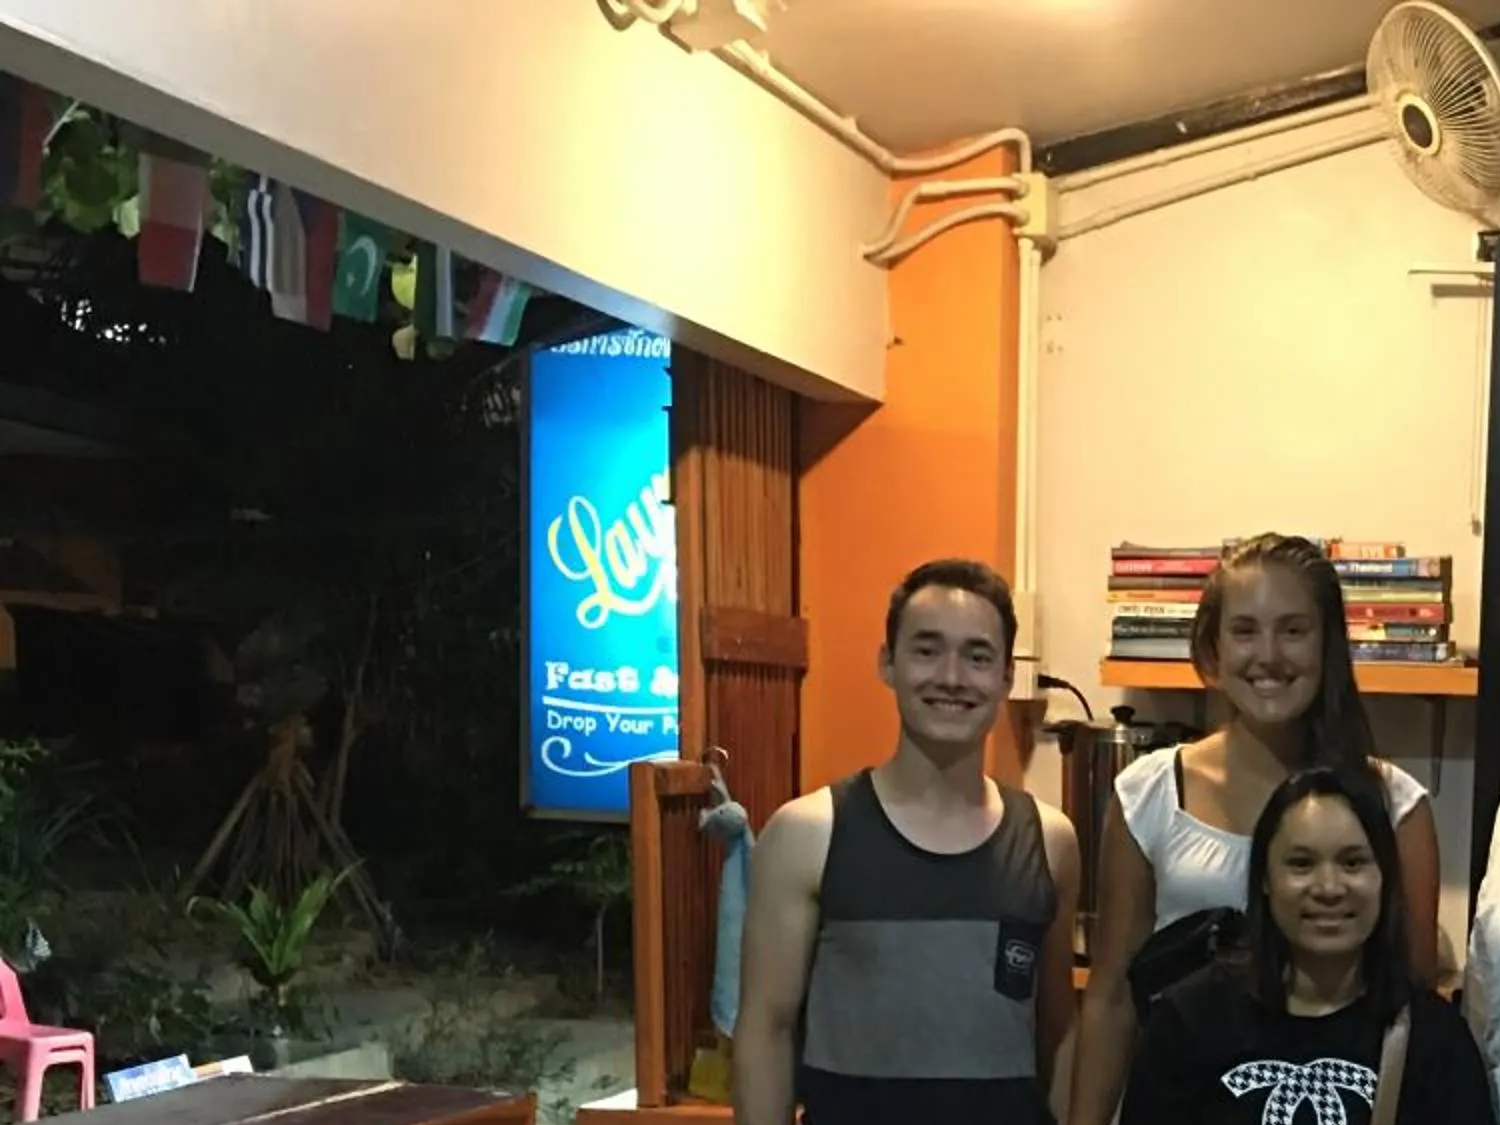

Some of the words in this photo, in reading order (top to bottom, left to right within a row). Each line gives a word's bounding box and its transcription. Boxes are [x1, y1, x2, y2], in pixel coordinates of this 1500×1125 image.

[547, 467, 678, 628] Lau
[545, 661, 640, 692] Fast
[547, 710, 597, 736] Drop
[605, 712, 654, 734] Your
[662, 715, 679, 734] P
